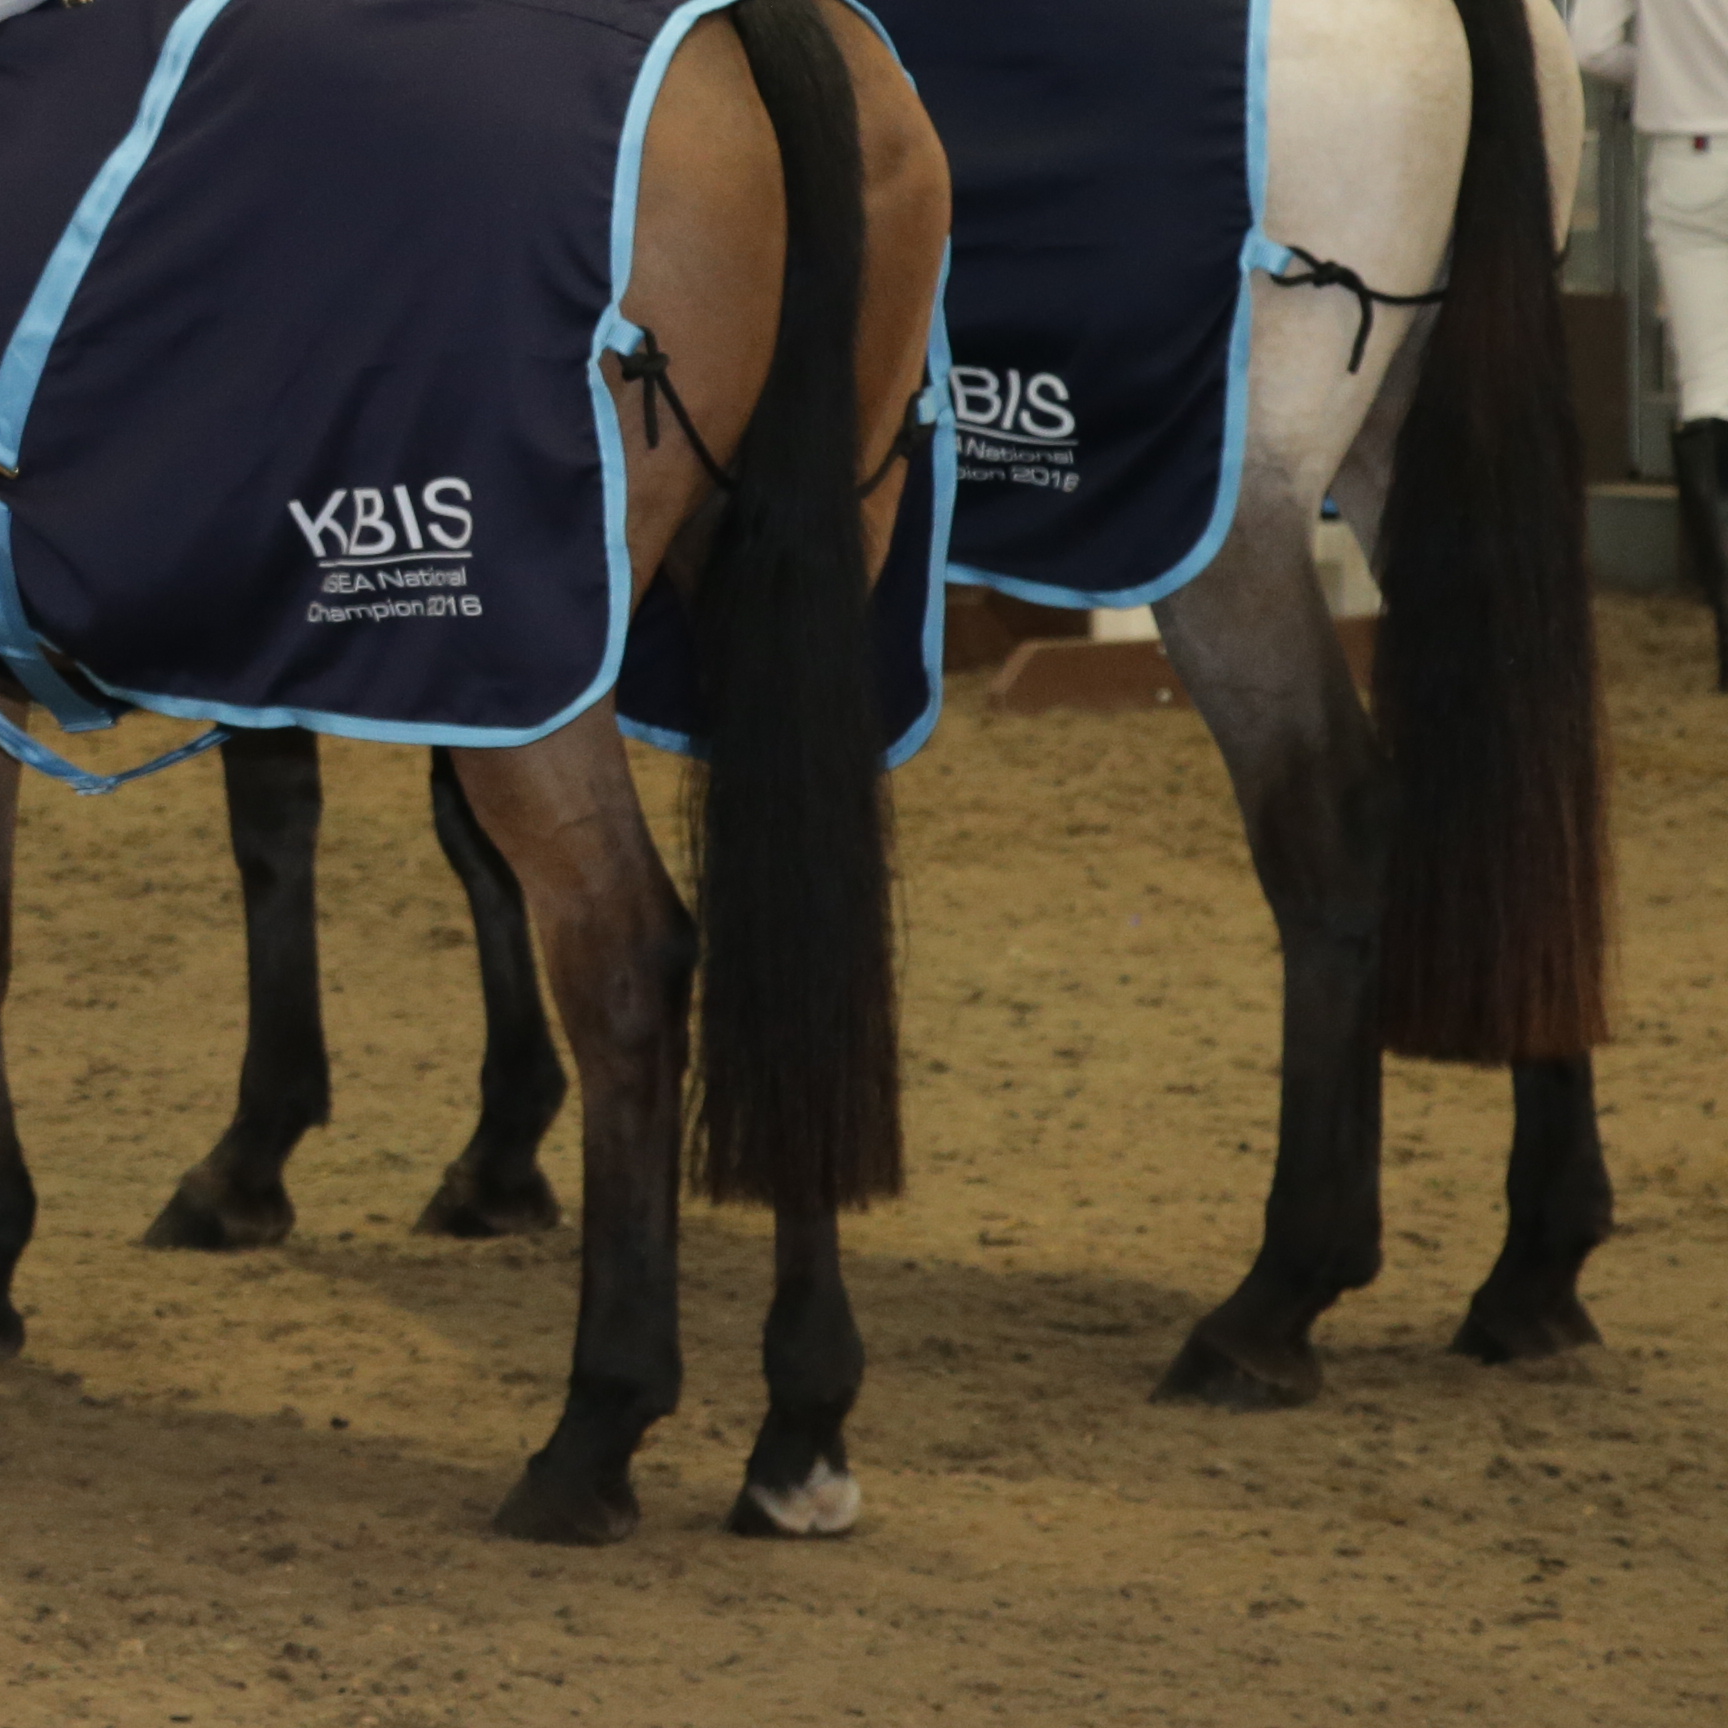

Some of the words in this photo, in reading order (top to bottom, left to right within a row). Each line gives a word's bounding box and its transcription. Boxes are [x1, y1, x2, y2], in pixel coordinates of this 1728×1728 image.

[948, 364, 1076, 439] BIS
[1010, 465, 1080, 493] 2016
[287, 476, 473, 558] KBIS
[321, 572, 376, 594] SEA
[307, 597, 426, 623] Champion
